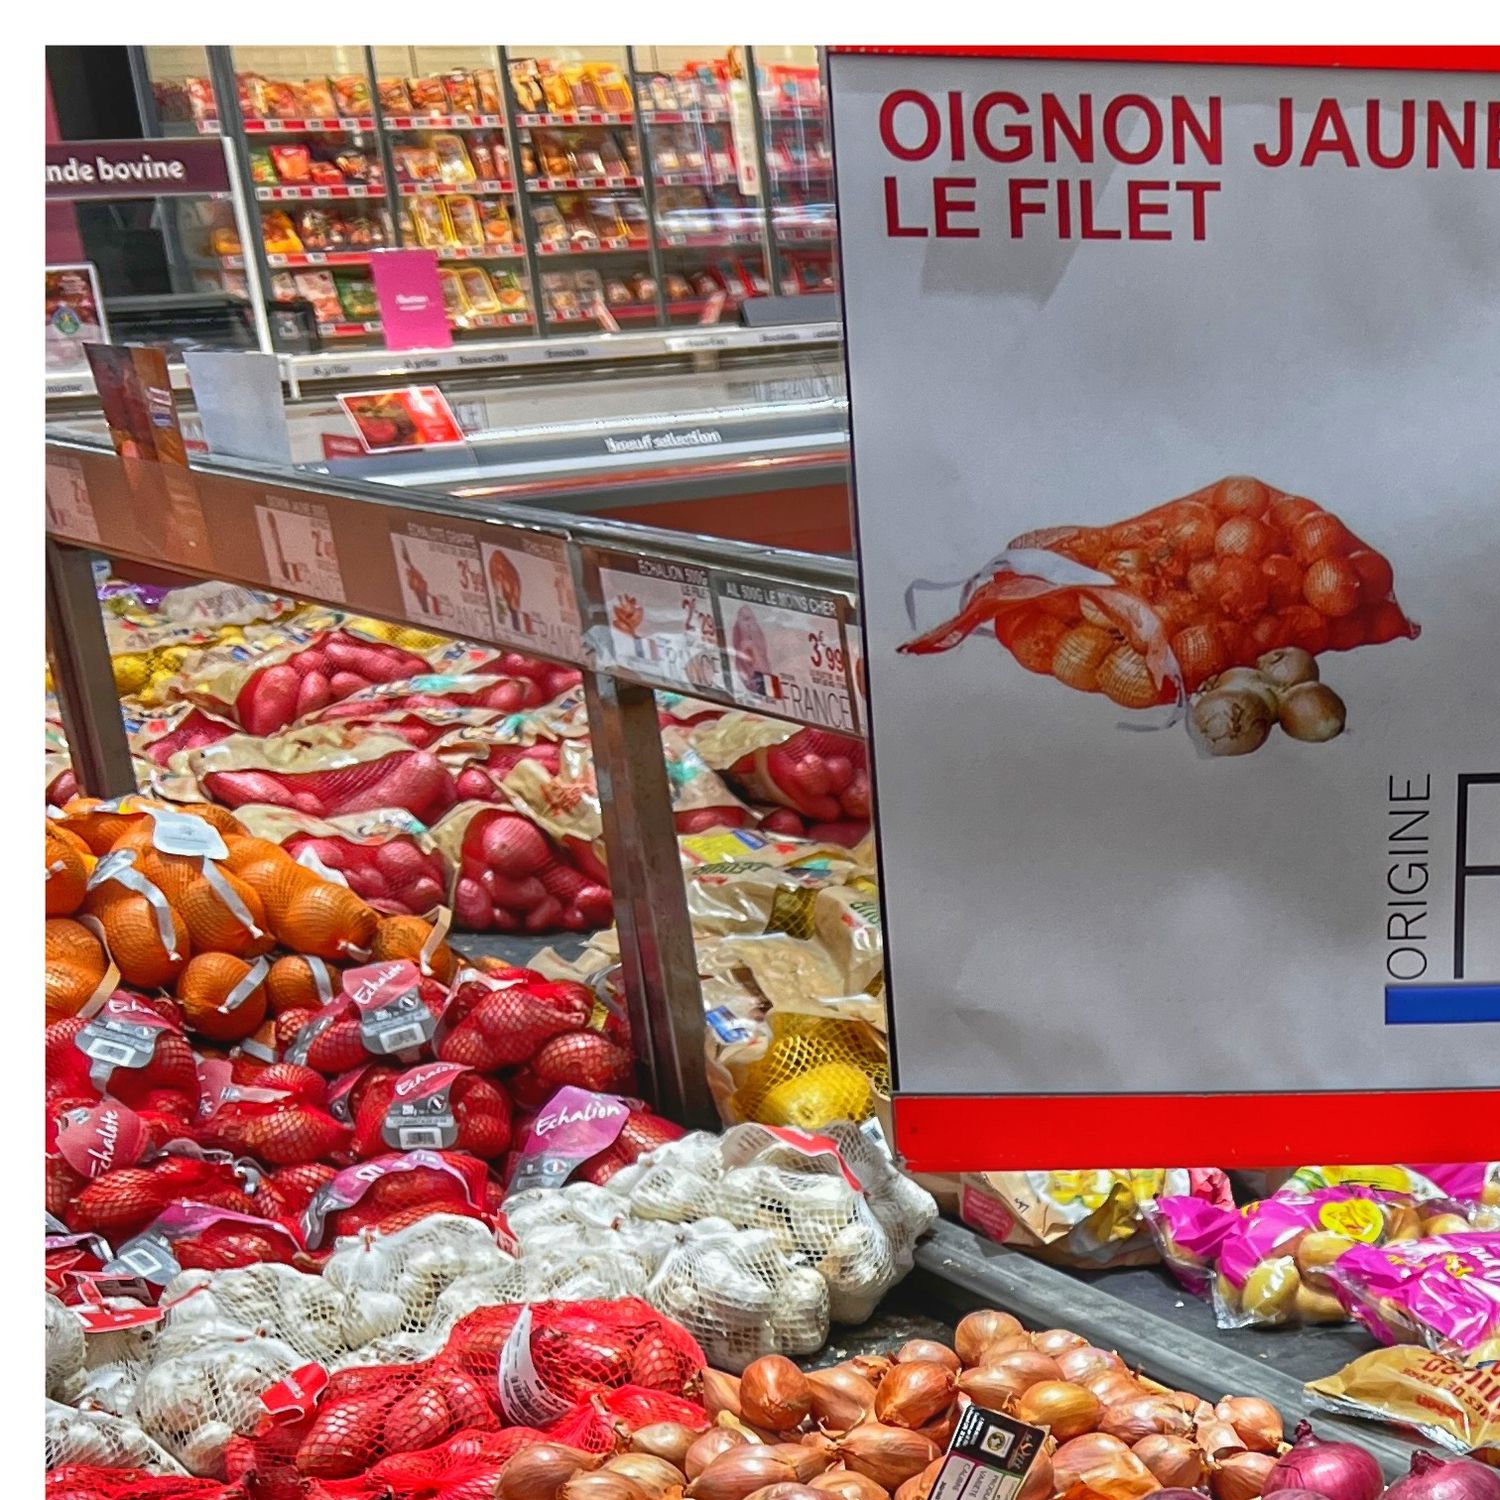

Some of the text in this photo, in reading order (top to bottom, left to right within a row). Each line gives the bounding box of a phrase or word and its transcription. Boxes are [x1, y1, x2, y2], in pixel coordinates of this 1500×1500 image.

[878, 89, 1223, 167] OIGNON
[96, 153, 186, 181] bovine
[884, 175, 1222, 241] LE FILET
[764, 590, 777, 605] LE
[808, 598, 837, 617] CHER
[781, 680, 854, 731] FRANCE
[1386, 770, 1433, 981] ORIGINE
[536, 1101, 621, 1137] Echalion
